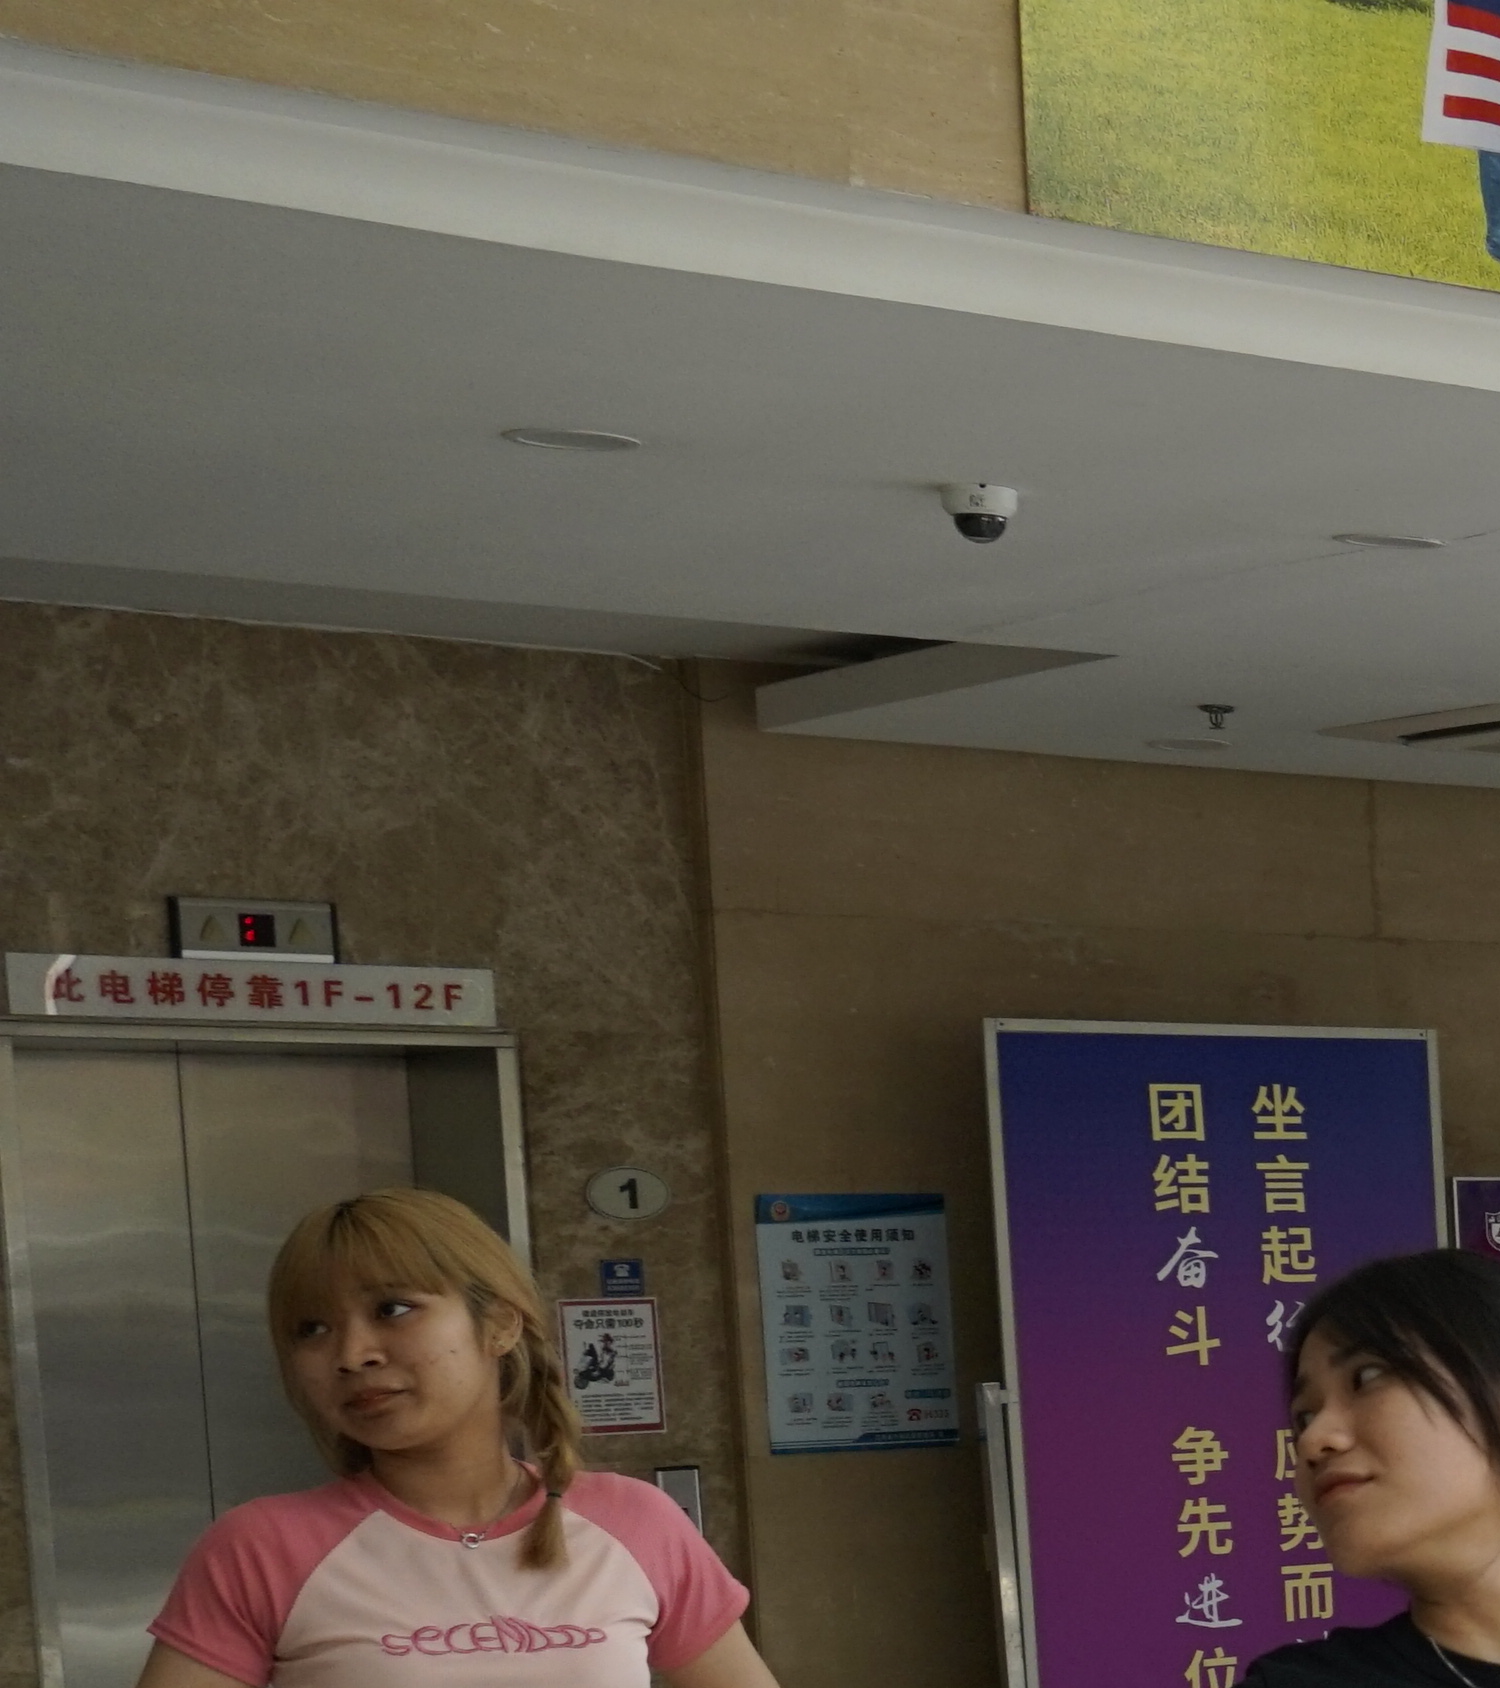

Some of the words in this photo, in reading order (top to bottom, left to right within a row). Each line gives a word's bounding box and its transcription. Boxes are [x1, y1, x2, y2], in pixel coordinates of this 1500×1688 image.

[53, 968, 464, 1012] 此电梯停靠1F-12F
[618, 1178, 640, 1210] 1
[791, 1227, 915, 1243] 电梯安全使用须知
[1147, 1083, 1221, 1367] 团结奋斗
